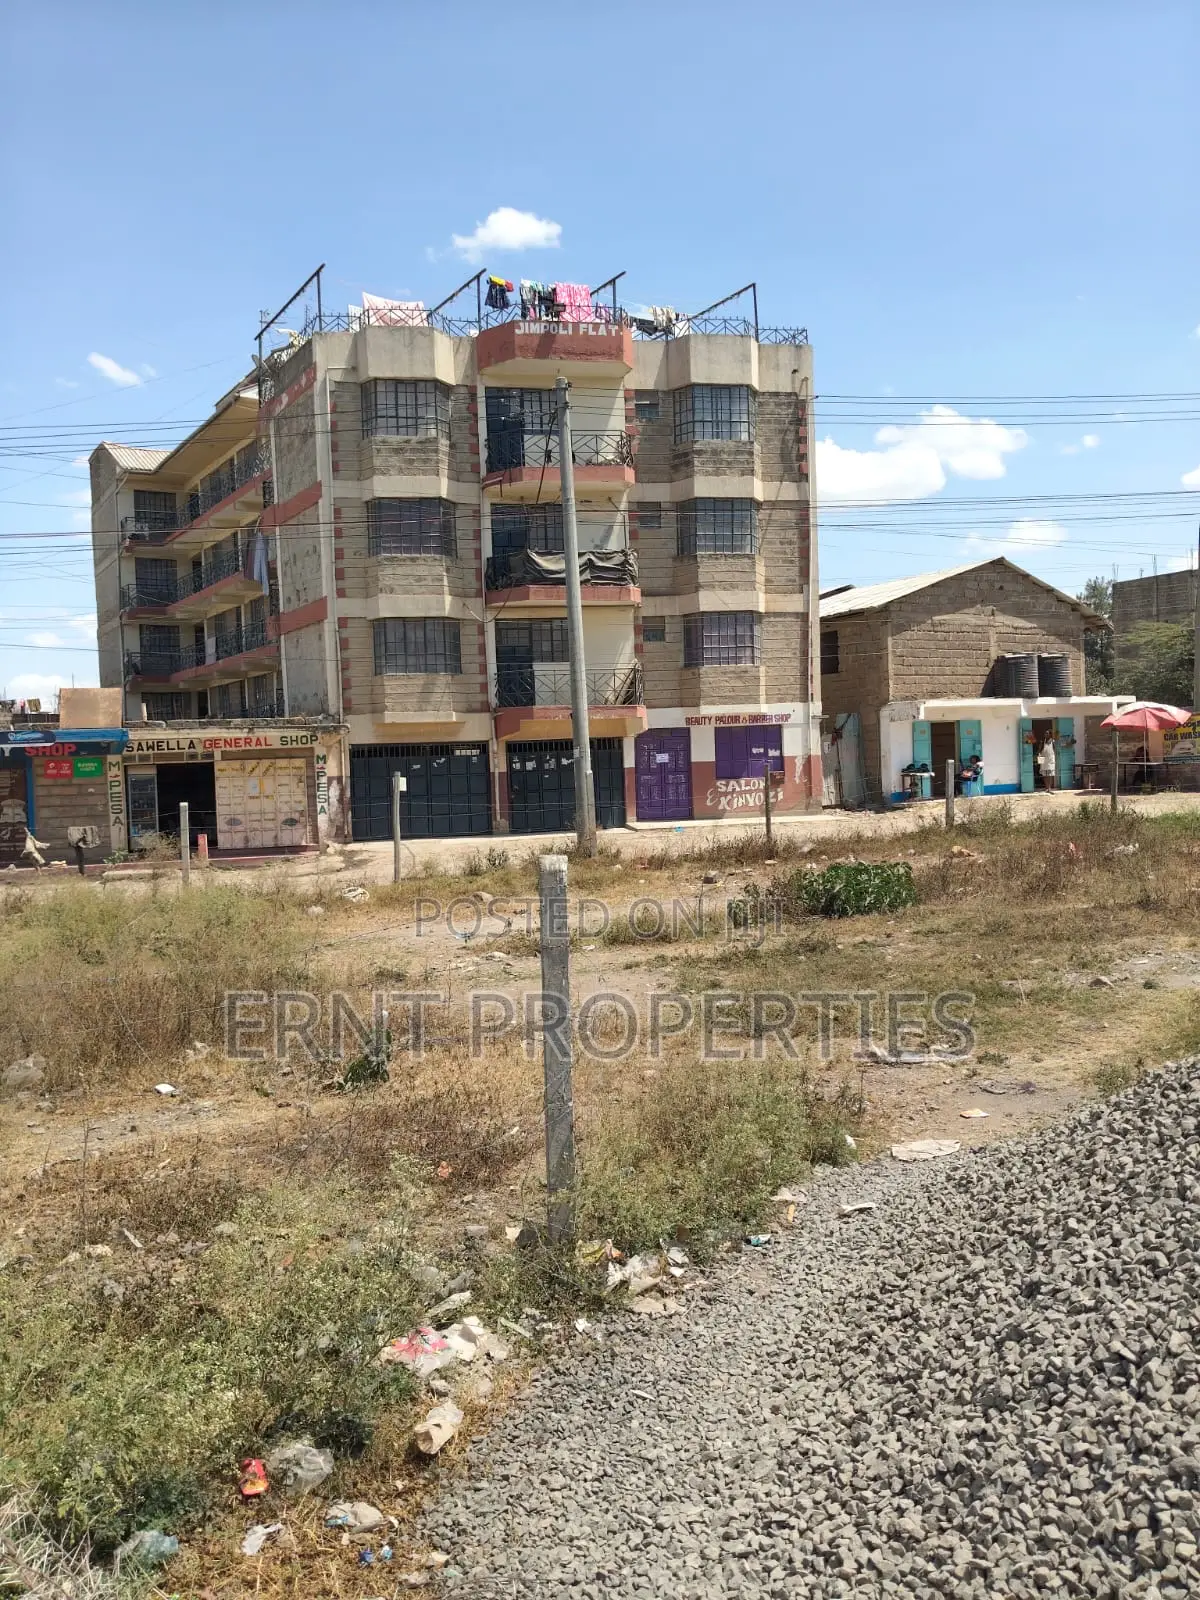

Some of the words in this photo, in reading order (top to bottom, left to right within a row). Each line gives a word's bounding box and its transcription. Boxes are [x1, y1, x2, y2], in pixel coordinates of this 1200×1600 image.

[515, 322, 573, 335] JIMPOLI
[685, 716, 713, 726] BEAUTY
[748, 714, 774, 724] BARBER
[774, 713, 792, 723] SHOP
[24, 743, 77, 757] SHOP
[125, 740, 196, 753] SAWELLA
[203, 736, 273, 751] GENERAL
